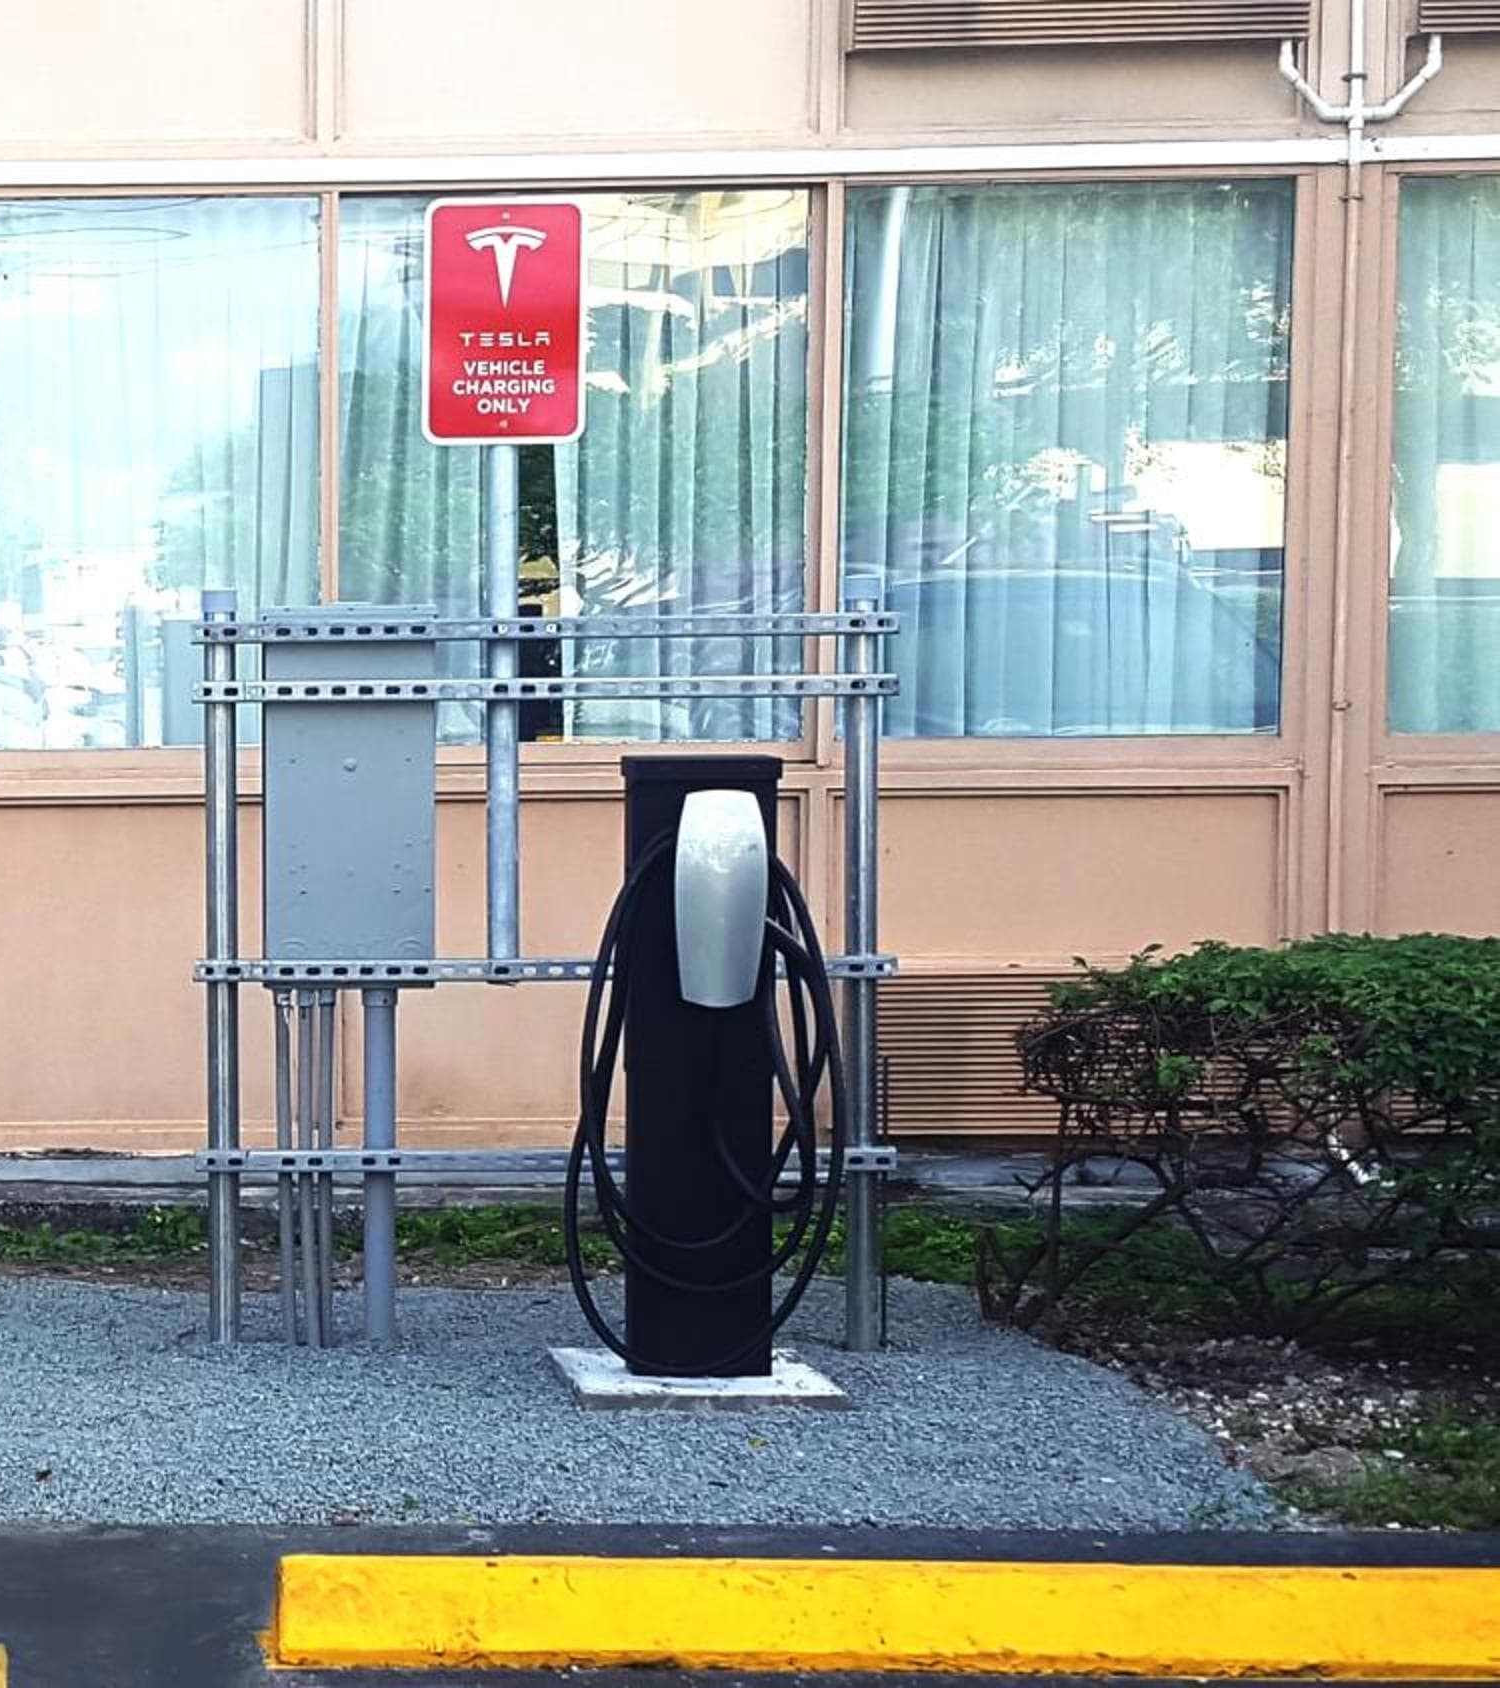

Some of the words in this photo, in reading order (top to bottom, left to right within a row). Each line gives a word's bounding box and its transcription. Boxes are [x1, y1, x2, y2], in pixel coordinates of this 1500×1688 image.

[459, 332, 550, 347] TESLA
[463, 360, 545, 376] VEHICLE
[453, 379, 555, 395] CHARGING
[477, 398, 531, 414] ONLY
